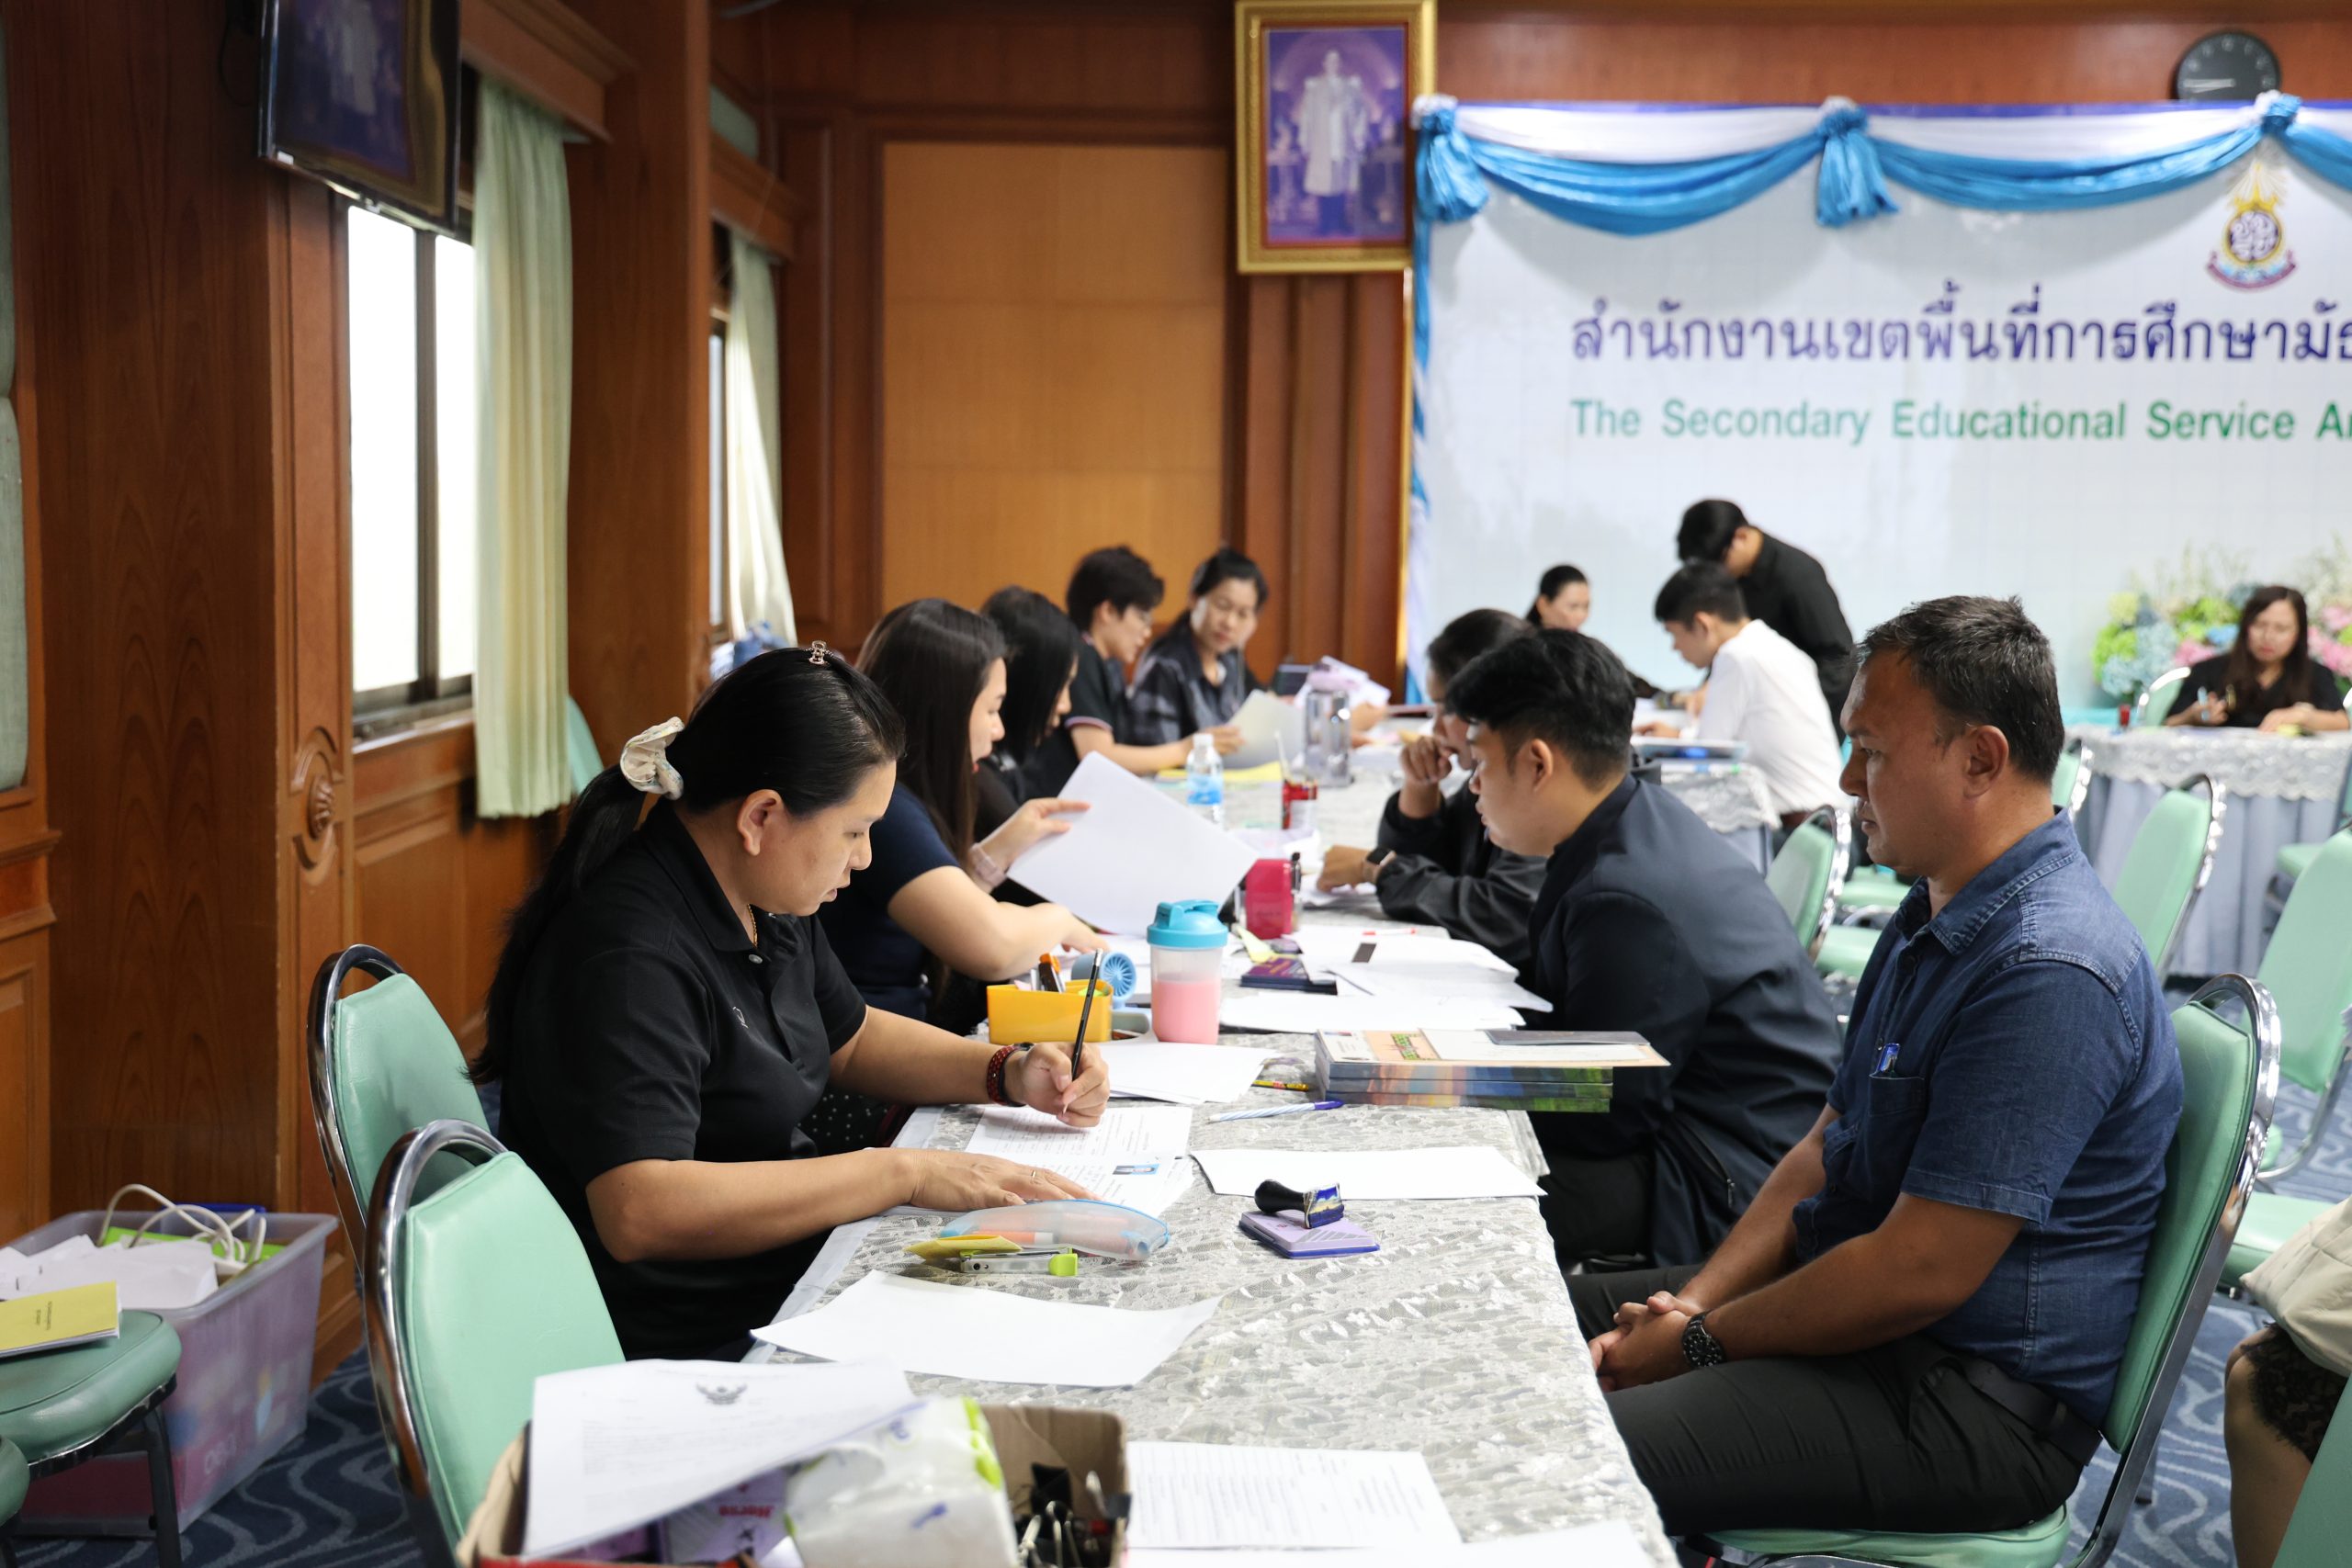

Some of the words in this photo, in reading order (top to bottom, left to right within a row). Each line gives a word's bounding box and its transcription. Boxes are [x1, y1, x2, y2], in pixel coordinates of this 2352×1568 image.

[1569, 400, 1642, 439] The
[1660, 399, 1871, 446] Secondary
[1893, 400, 2127, 439] Educational
[2146, 400, 2296, 440] Service
[2316, 400, 2352, 440] A
